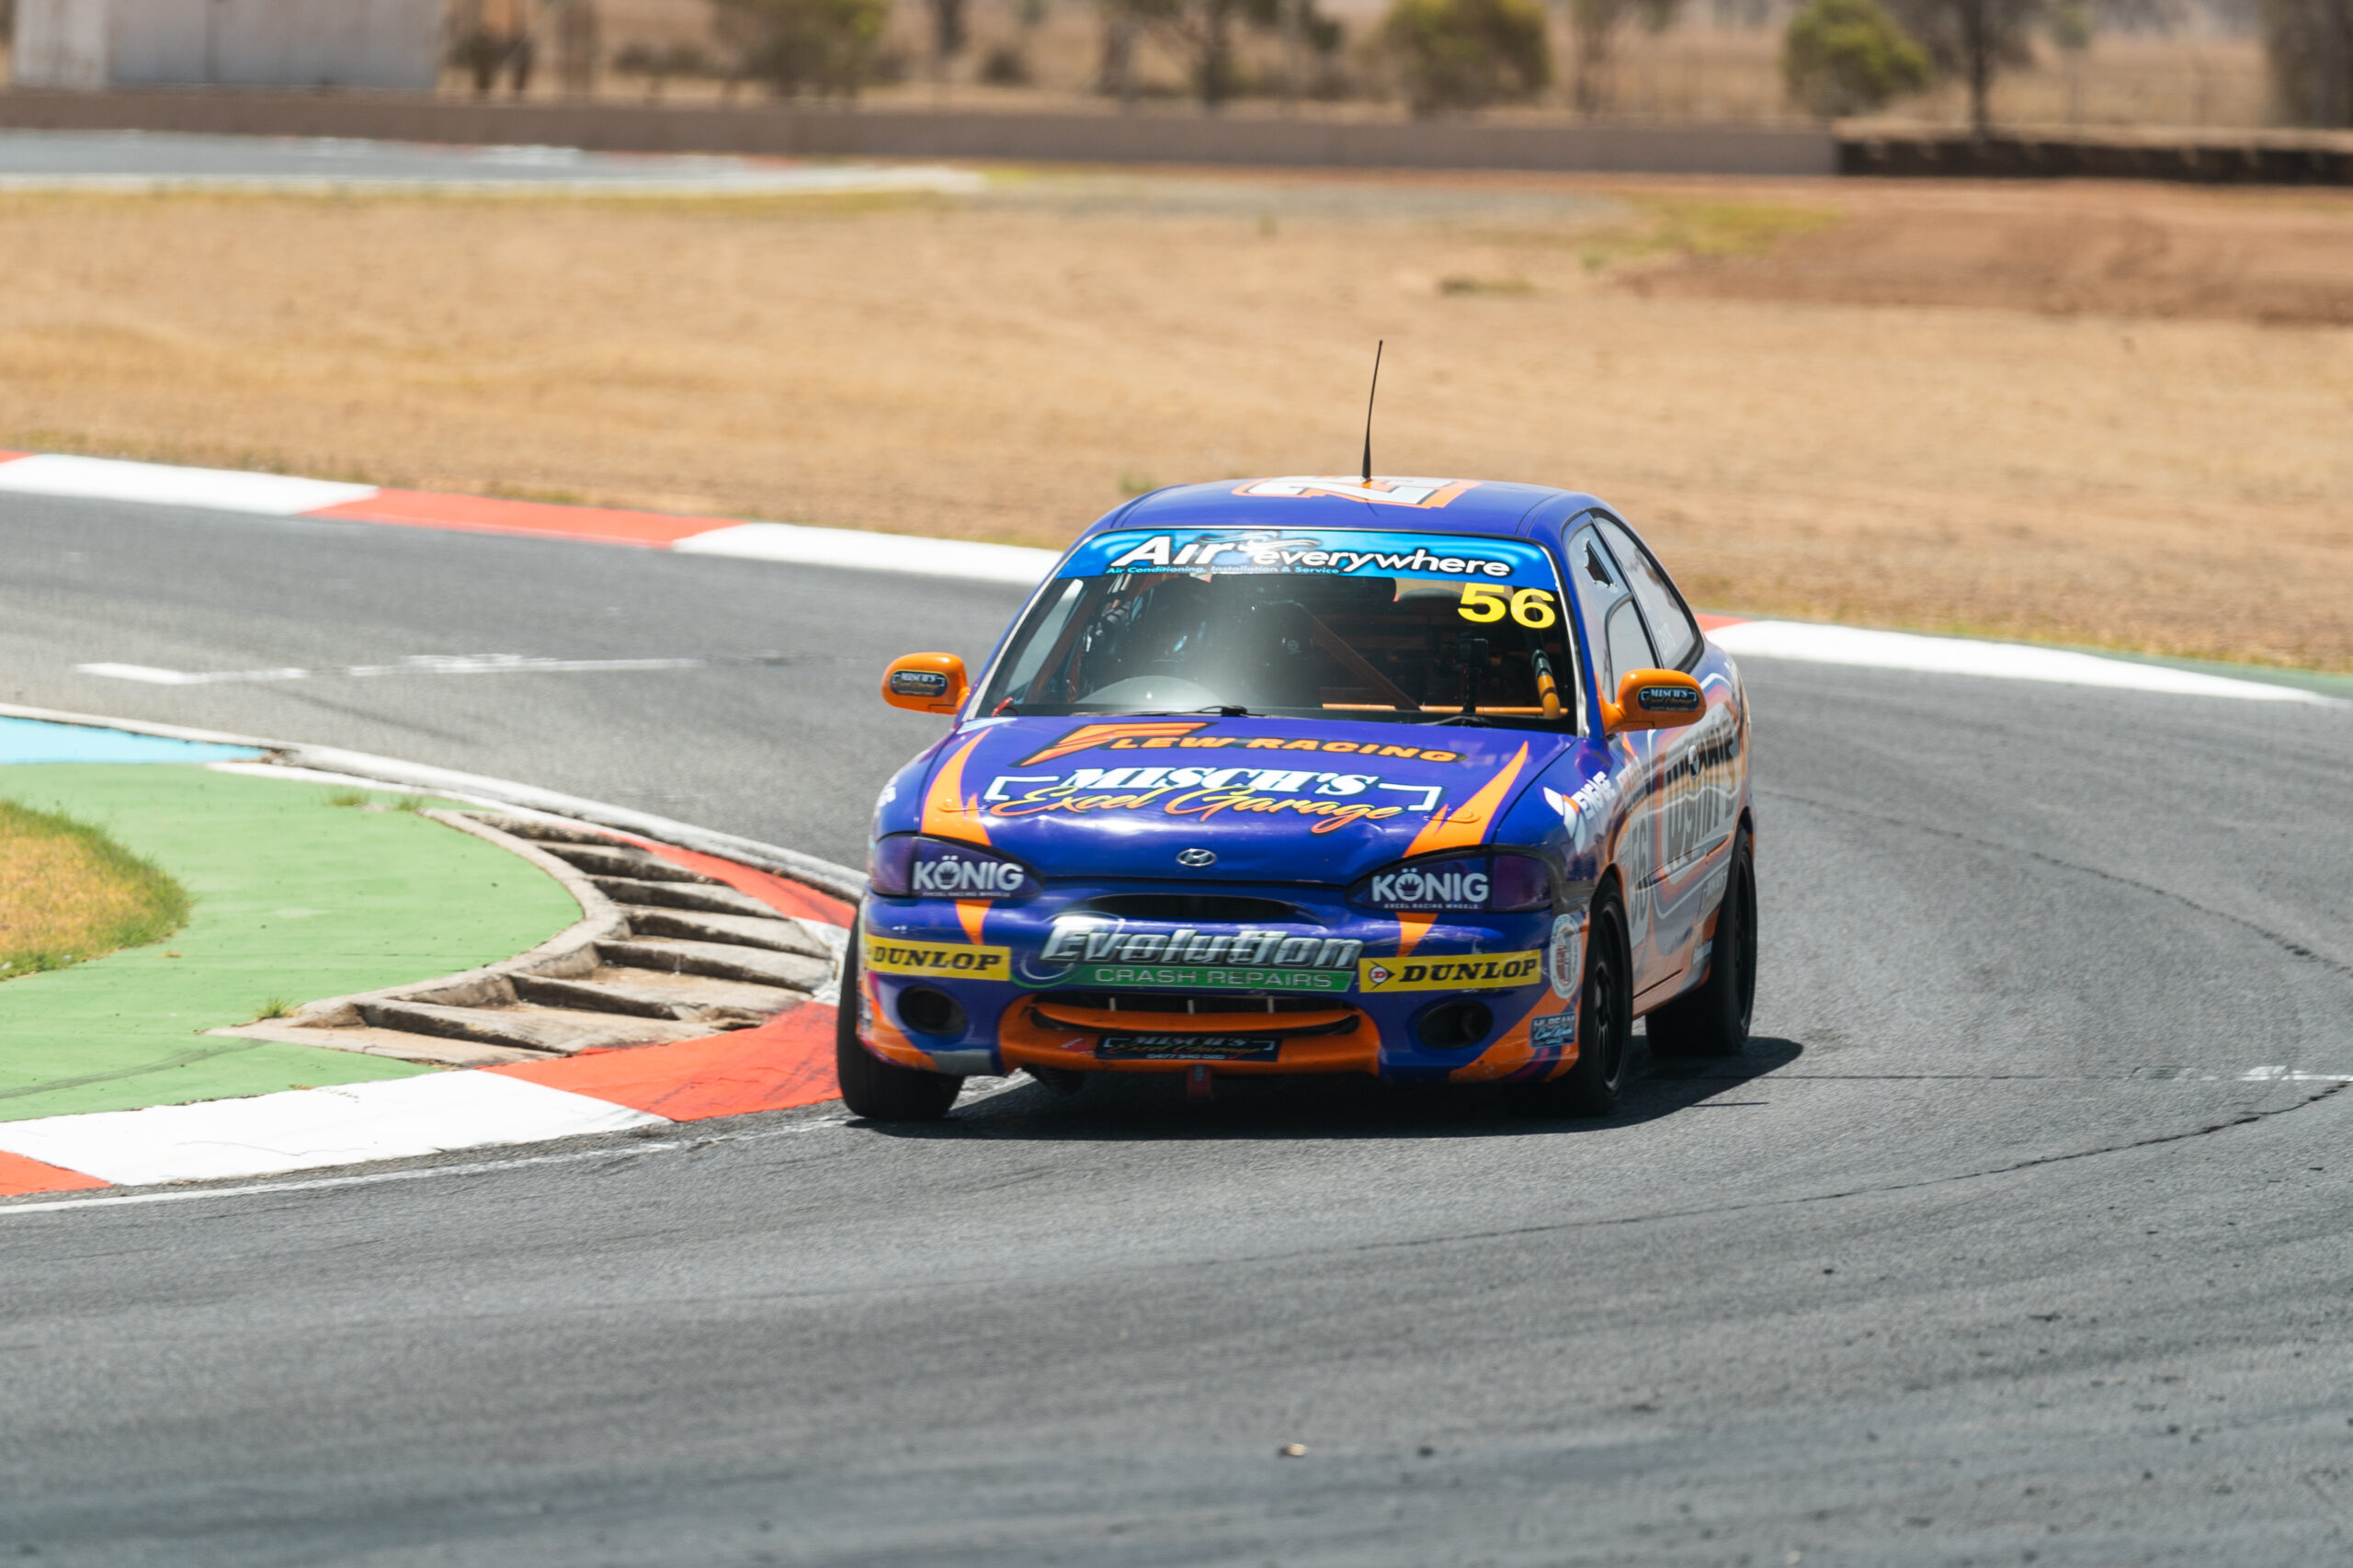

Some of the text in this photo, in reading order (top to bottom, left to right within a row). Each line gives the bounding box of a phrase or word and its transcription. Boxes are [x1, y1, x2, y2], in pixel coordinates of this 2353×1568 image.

[1106, 566, 1125, 574] Air
[1211, 565, 1279, 574] Installation
[1280, 566, 1290, 574] &
[1295, 566, 1340, 574] Service
[1110, 535, 1511, 577] Air everywhere
[1458, 582, 1556, 630] 56
[1246, 736, 1460, 762] RACING
[1062, 767, 1379, 797] MISCH'S
[990, 785, 1404, 834] Excel Garage
[911, 855, 1025, 891] KÖNIG
[1371, 868, 1489, 903] KÖNIG
[872, 945, 1003, 971] DUNLOP
[1040, 919, 1365, 968] Evolution
[1095, 968, 1332, 988] CRASH REPAIRS
[1398, 958, 1538, 983] DUNLOP
